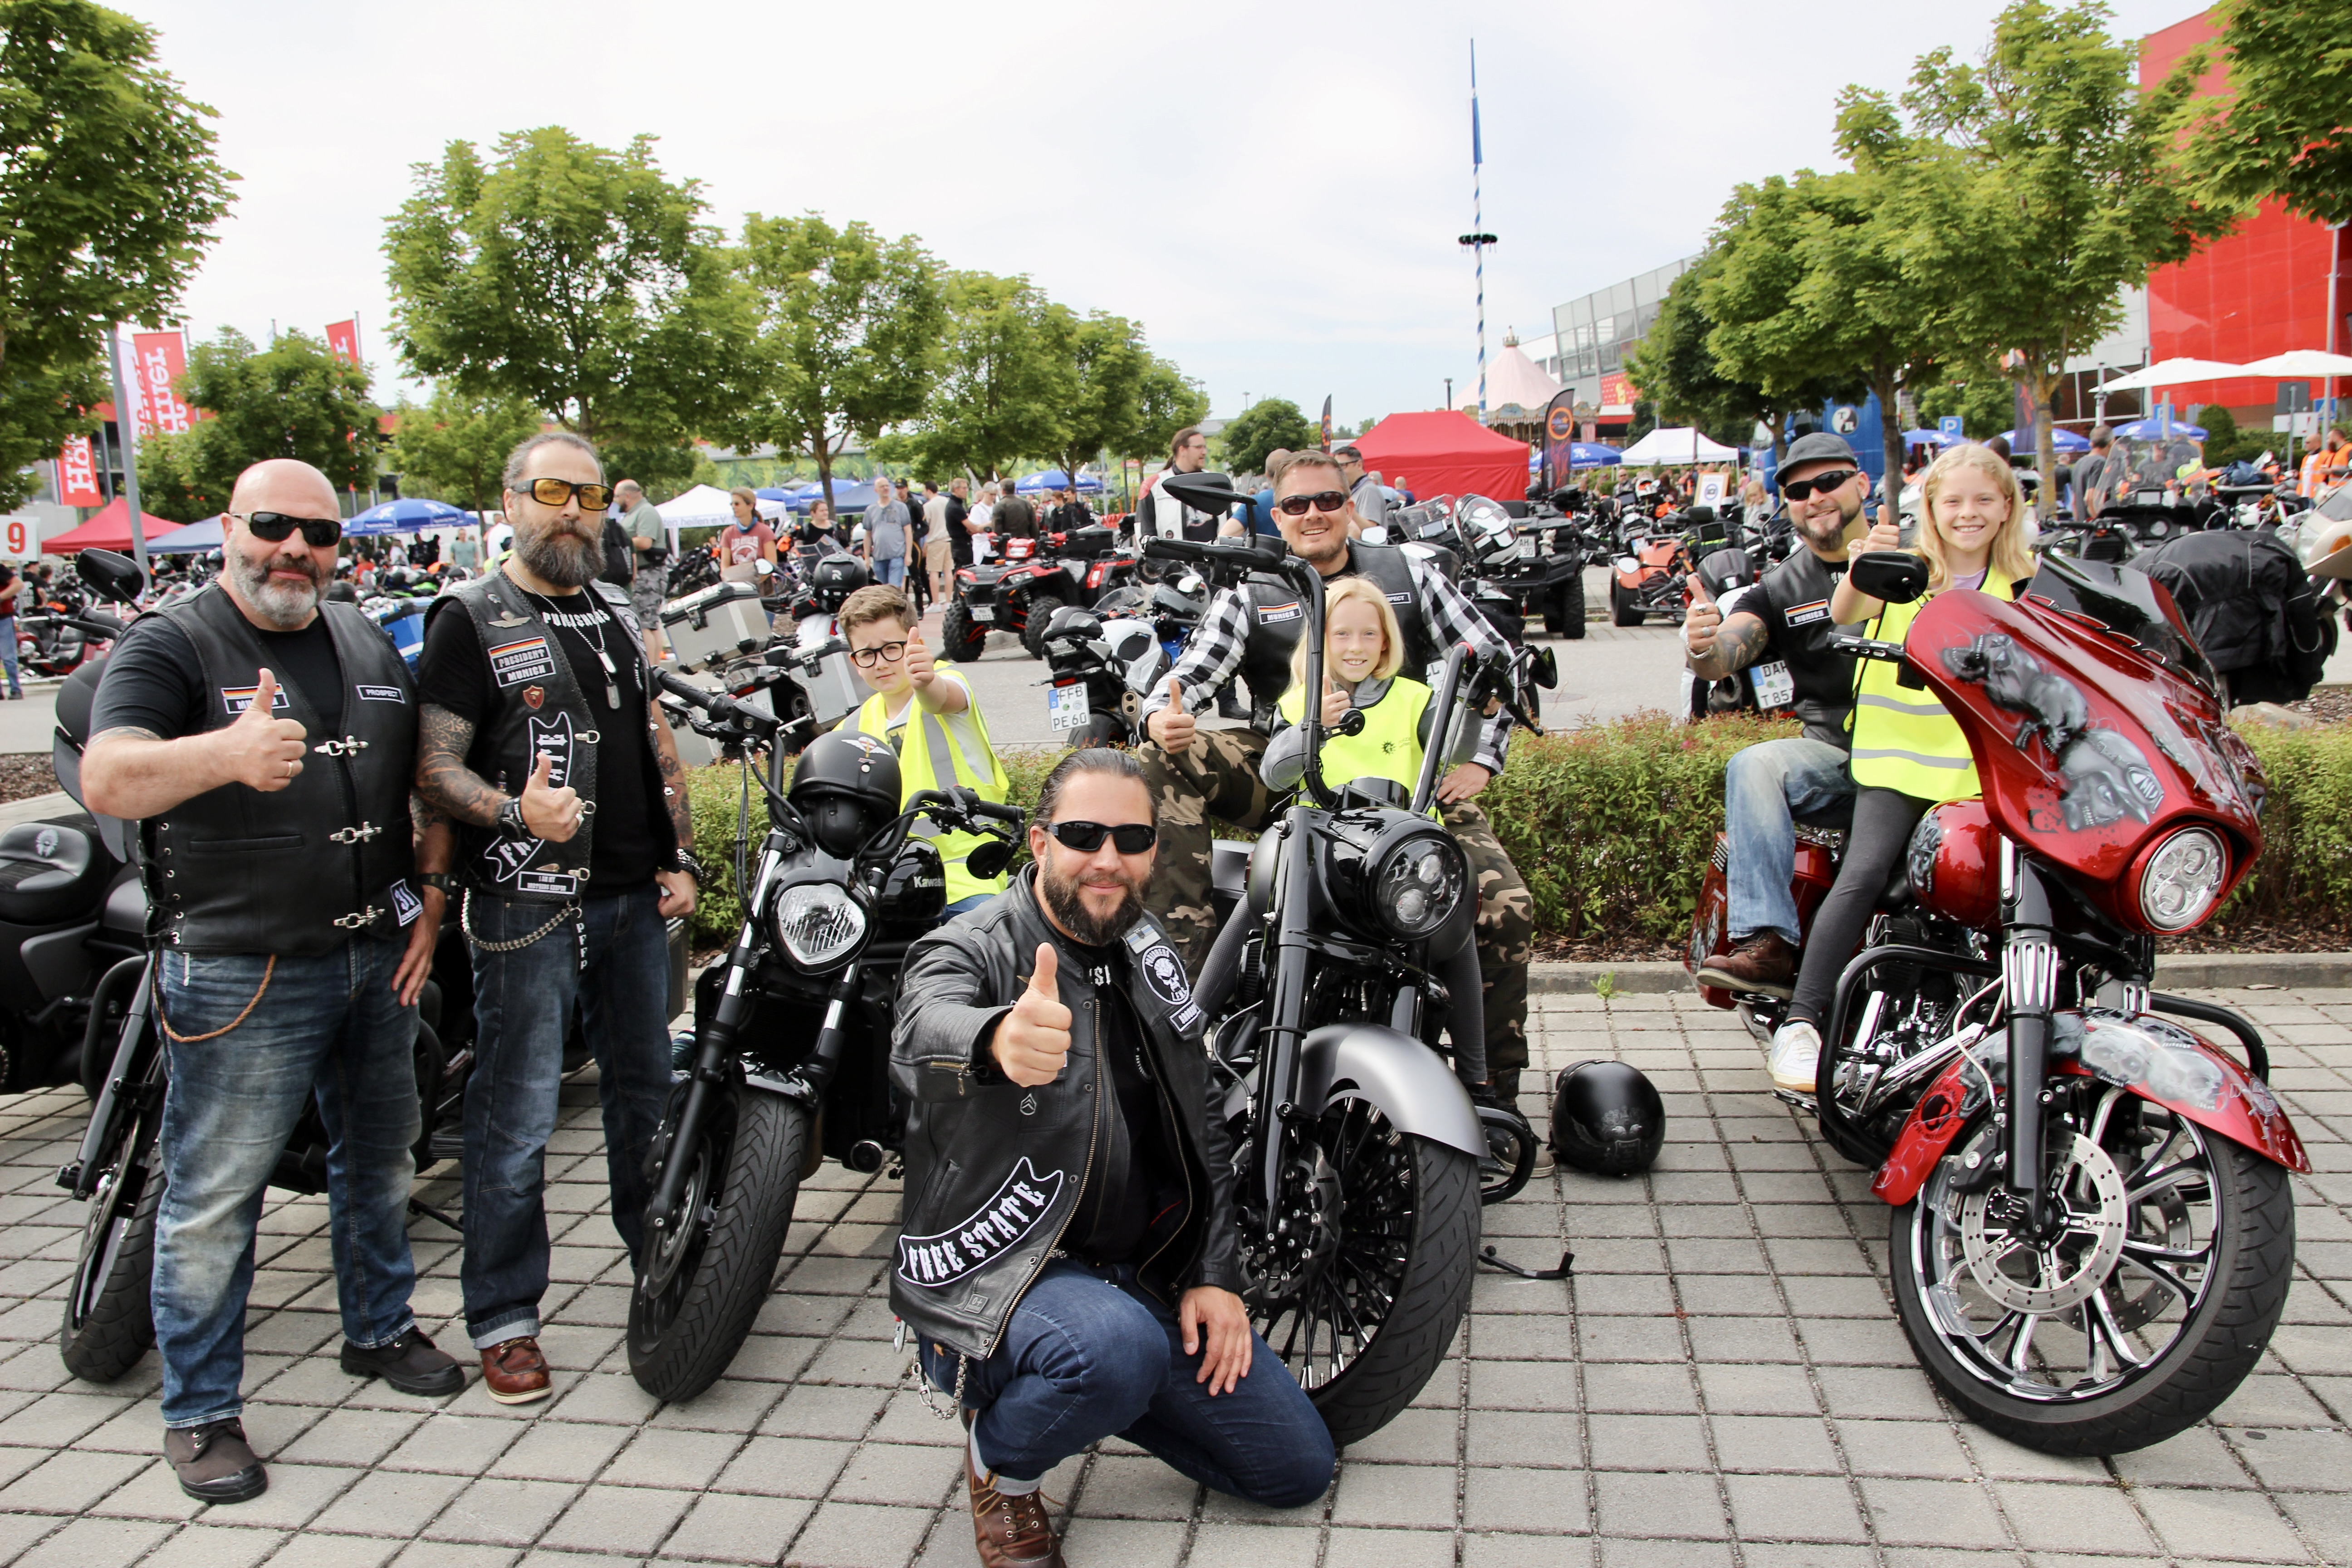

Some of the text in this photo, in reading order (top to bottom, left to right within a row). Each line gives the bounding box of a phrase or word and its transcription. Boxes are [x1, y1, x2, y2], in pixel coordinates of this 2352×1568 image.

[1944, 419, 1957, 433] P
[8, 522, 26, 554] 9
[832, 569, 843, 580] R
[1267, 609, 1295, 621] MUNICH
[1794, 610, 1824, 624] MUNICH
[498, 649, 545, 668] PRESIDENT
[507, 664, 546, 682] MUNICH
[365, 689, 398, 698] PROSPECT
[1058, 686, 1083, 701] FFB
[1762, 695, 1769, 706] T
[1053, 712, 1087, 730] PE 60
[908, 1181, 1046, 1282] FREE STATE
